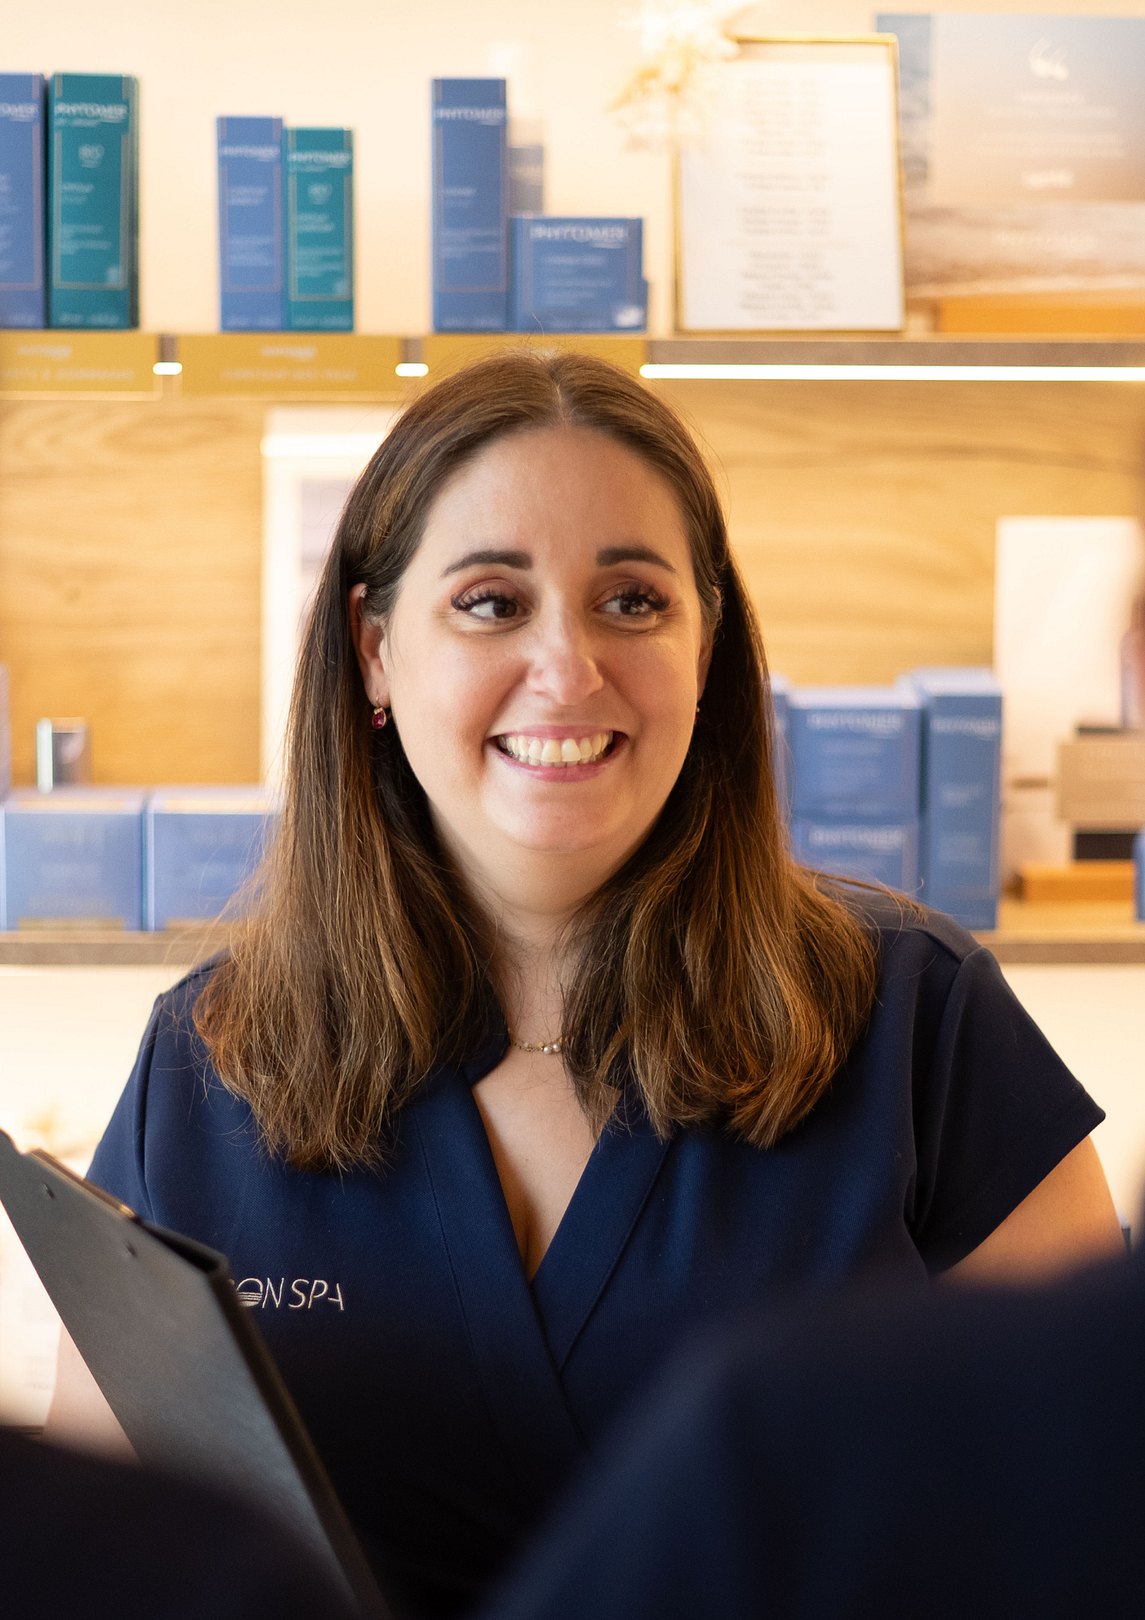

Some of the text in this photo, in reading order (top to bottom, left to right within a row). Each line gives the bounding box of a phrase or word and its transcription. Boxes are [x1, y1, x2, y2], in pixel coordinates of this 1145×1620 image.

[530, 225, 628, 242] PHYTOMER
[229, 1277, 345, 1311] ON SPA
